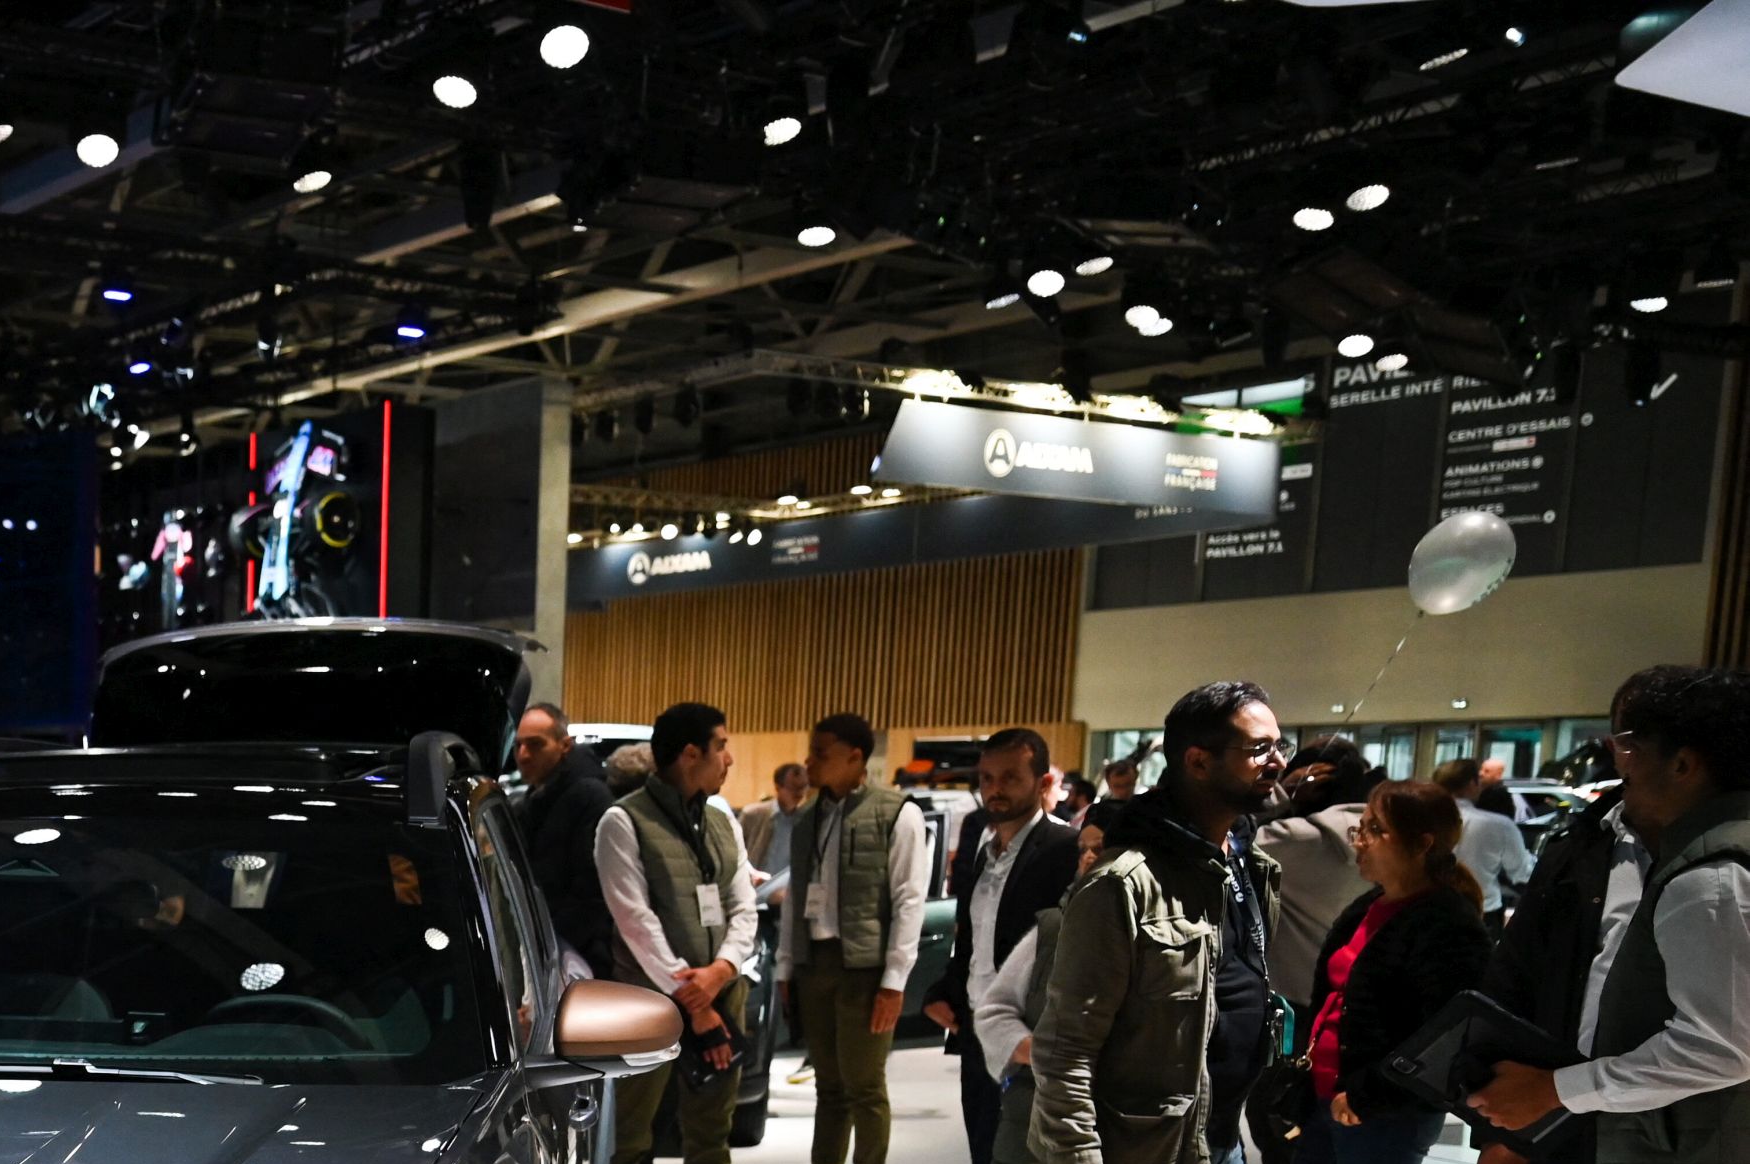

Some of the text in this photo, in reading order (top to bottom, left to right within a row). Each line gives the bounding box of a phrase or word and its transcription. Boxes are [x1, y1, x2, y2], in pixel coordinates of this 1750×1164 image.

[1330, 384, 1402, 409] SERELLE
[1447, 416, 1571, 443] CENTRE D'ESSAIS
[1444, 457, 1530, 478] ANIMATIONS
[1206, 544, 1265, 559] PAVILLON
